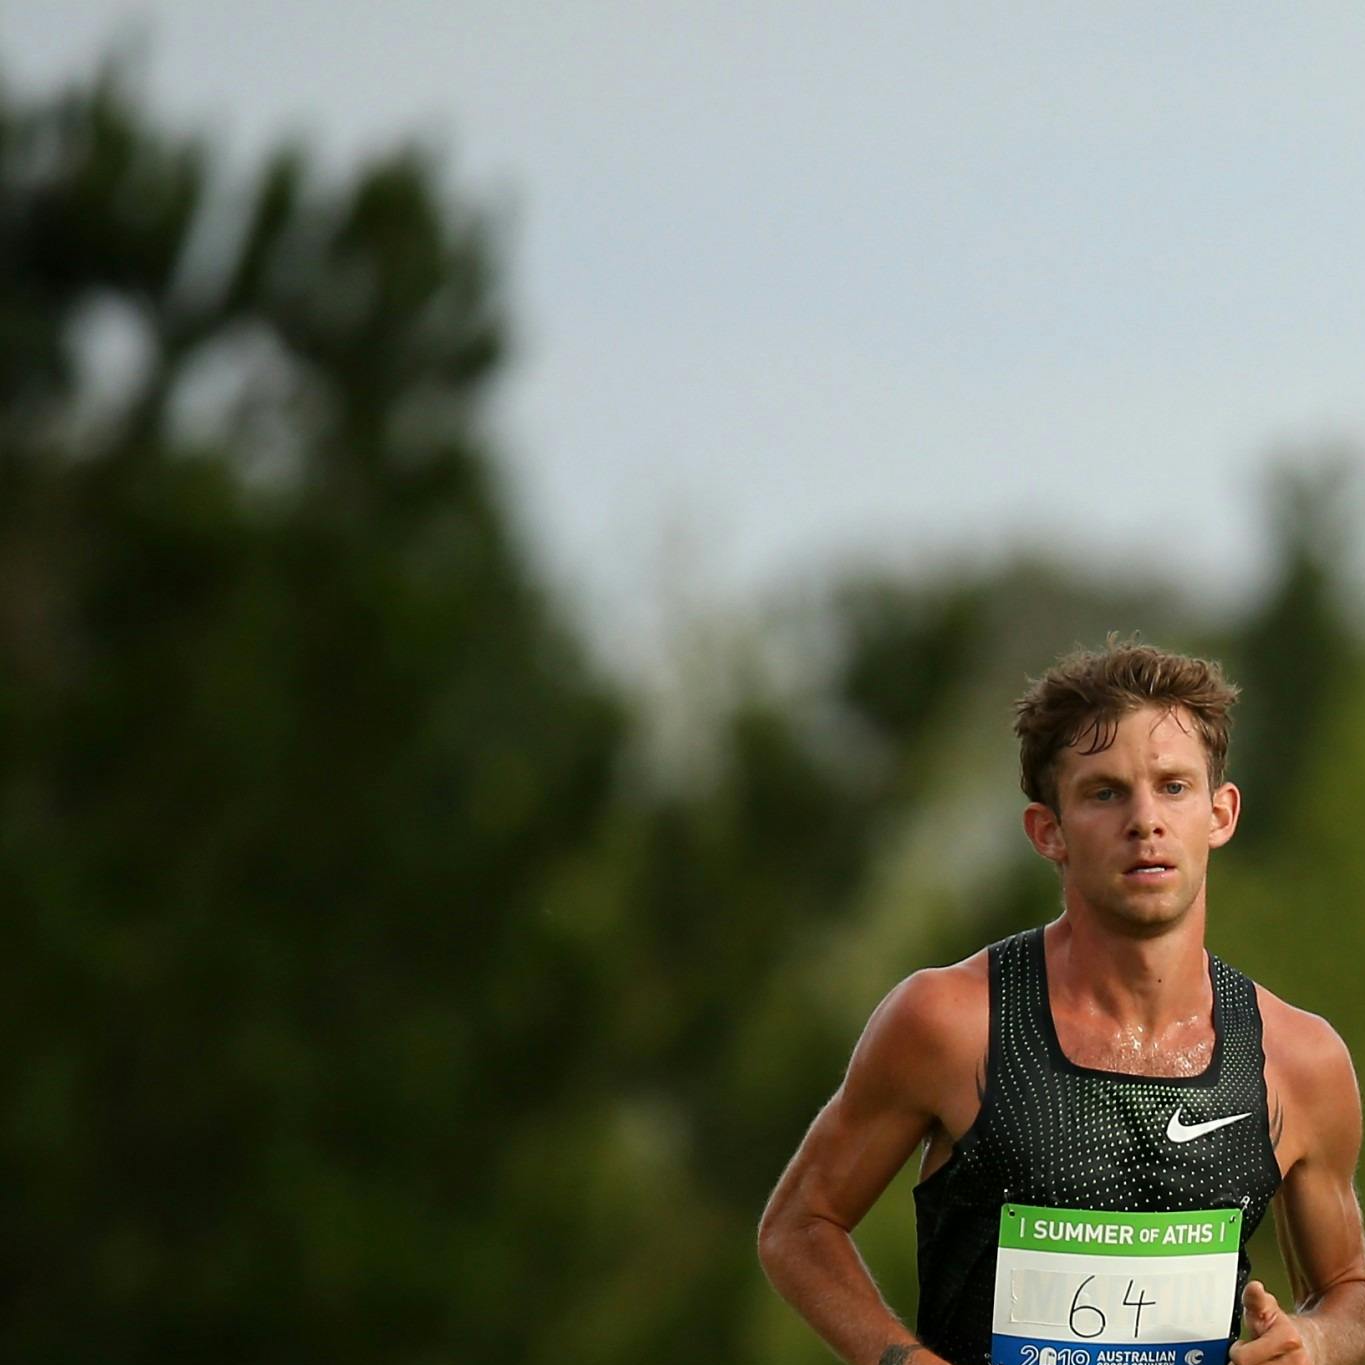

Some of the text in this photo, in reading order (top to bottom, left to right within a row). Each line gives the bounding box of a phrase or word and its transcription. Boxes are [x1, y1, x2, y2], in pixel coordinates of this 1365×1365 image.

[1033, 1220, 1213, 1245] SUMMER OF ATHS
[1069, 1275, 1156, 1339] 64
[1096, 1350, 1176, 1363] AUSTRALIAN
